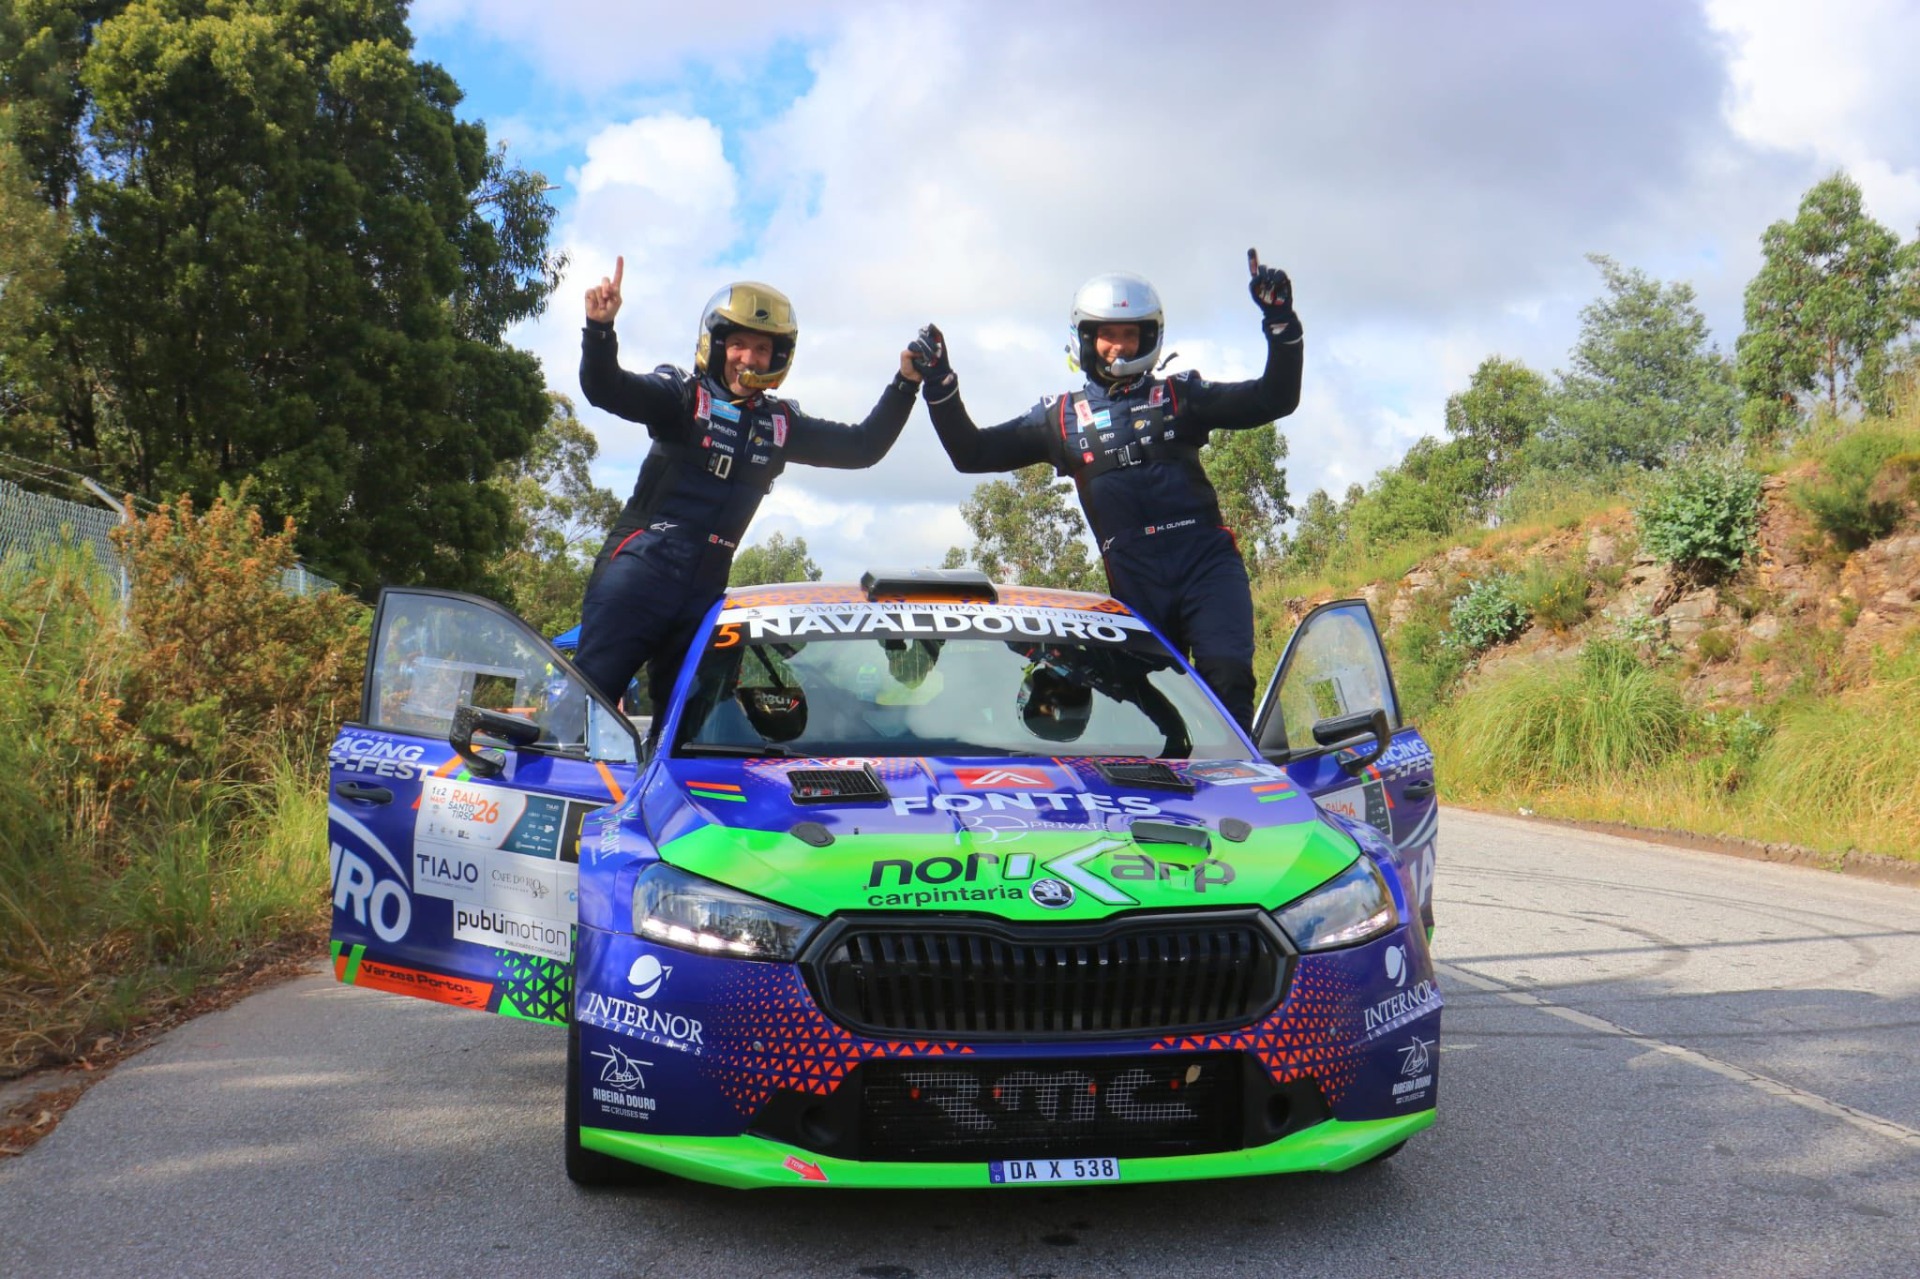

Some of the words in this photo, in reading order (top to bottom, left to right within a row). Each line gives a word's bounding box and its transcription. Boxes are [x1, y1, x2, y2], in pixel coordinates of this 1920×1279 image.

[881, 603, 988, 613] MUNICIPAL
[996, 605, 1056, 617] SANTO
[1063, 611, 1113, 624] TIRSO
[713, 622, 742, 649] 5
[749, 613, 1128, 642] NAVALDOURO
[330, 736, 425, 762] ACING
[356, 755, 441, 782] FEST
[1407, 752, 1434, 776] FES
[447, 800, 475, 813] SANTO
[451, 788, 481, 806] RALI
[891, 792, 1162, 816] FONTES
[452, 809, 475, 821] TIRSO
[474, 798, 501, 824] 26
[416, 853, 479, 884] TIAJO
[867, 885, 1024, 907] carpintaria
[457, 909, 567, 947] publimotion
[360, 962, 415, 983] Varzea
[416, 974, 473, 994] Portos
[583, 992, 704, 1045] INTERNOR
[1363, 980, 1438, 1031] INTERNOR
[578, 1014, 703, 1056] INTERIORES
[592, 1087, 625, 1105] RIBEIRA
[626, 1094, 656, 1111] DOURO
[1010, 1161, 1037, 1180] DA
[1049, 1160, 1062, 1179] X
[1074, 1159, 1114, 1178] 538
